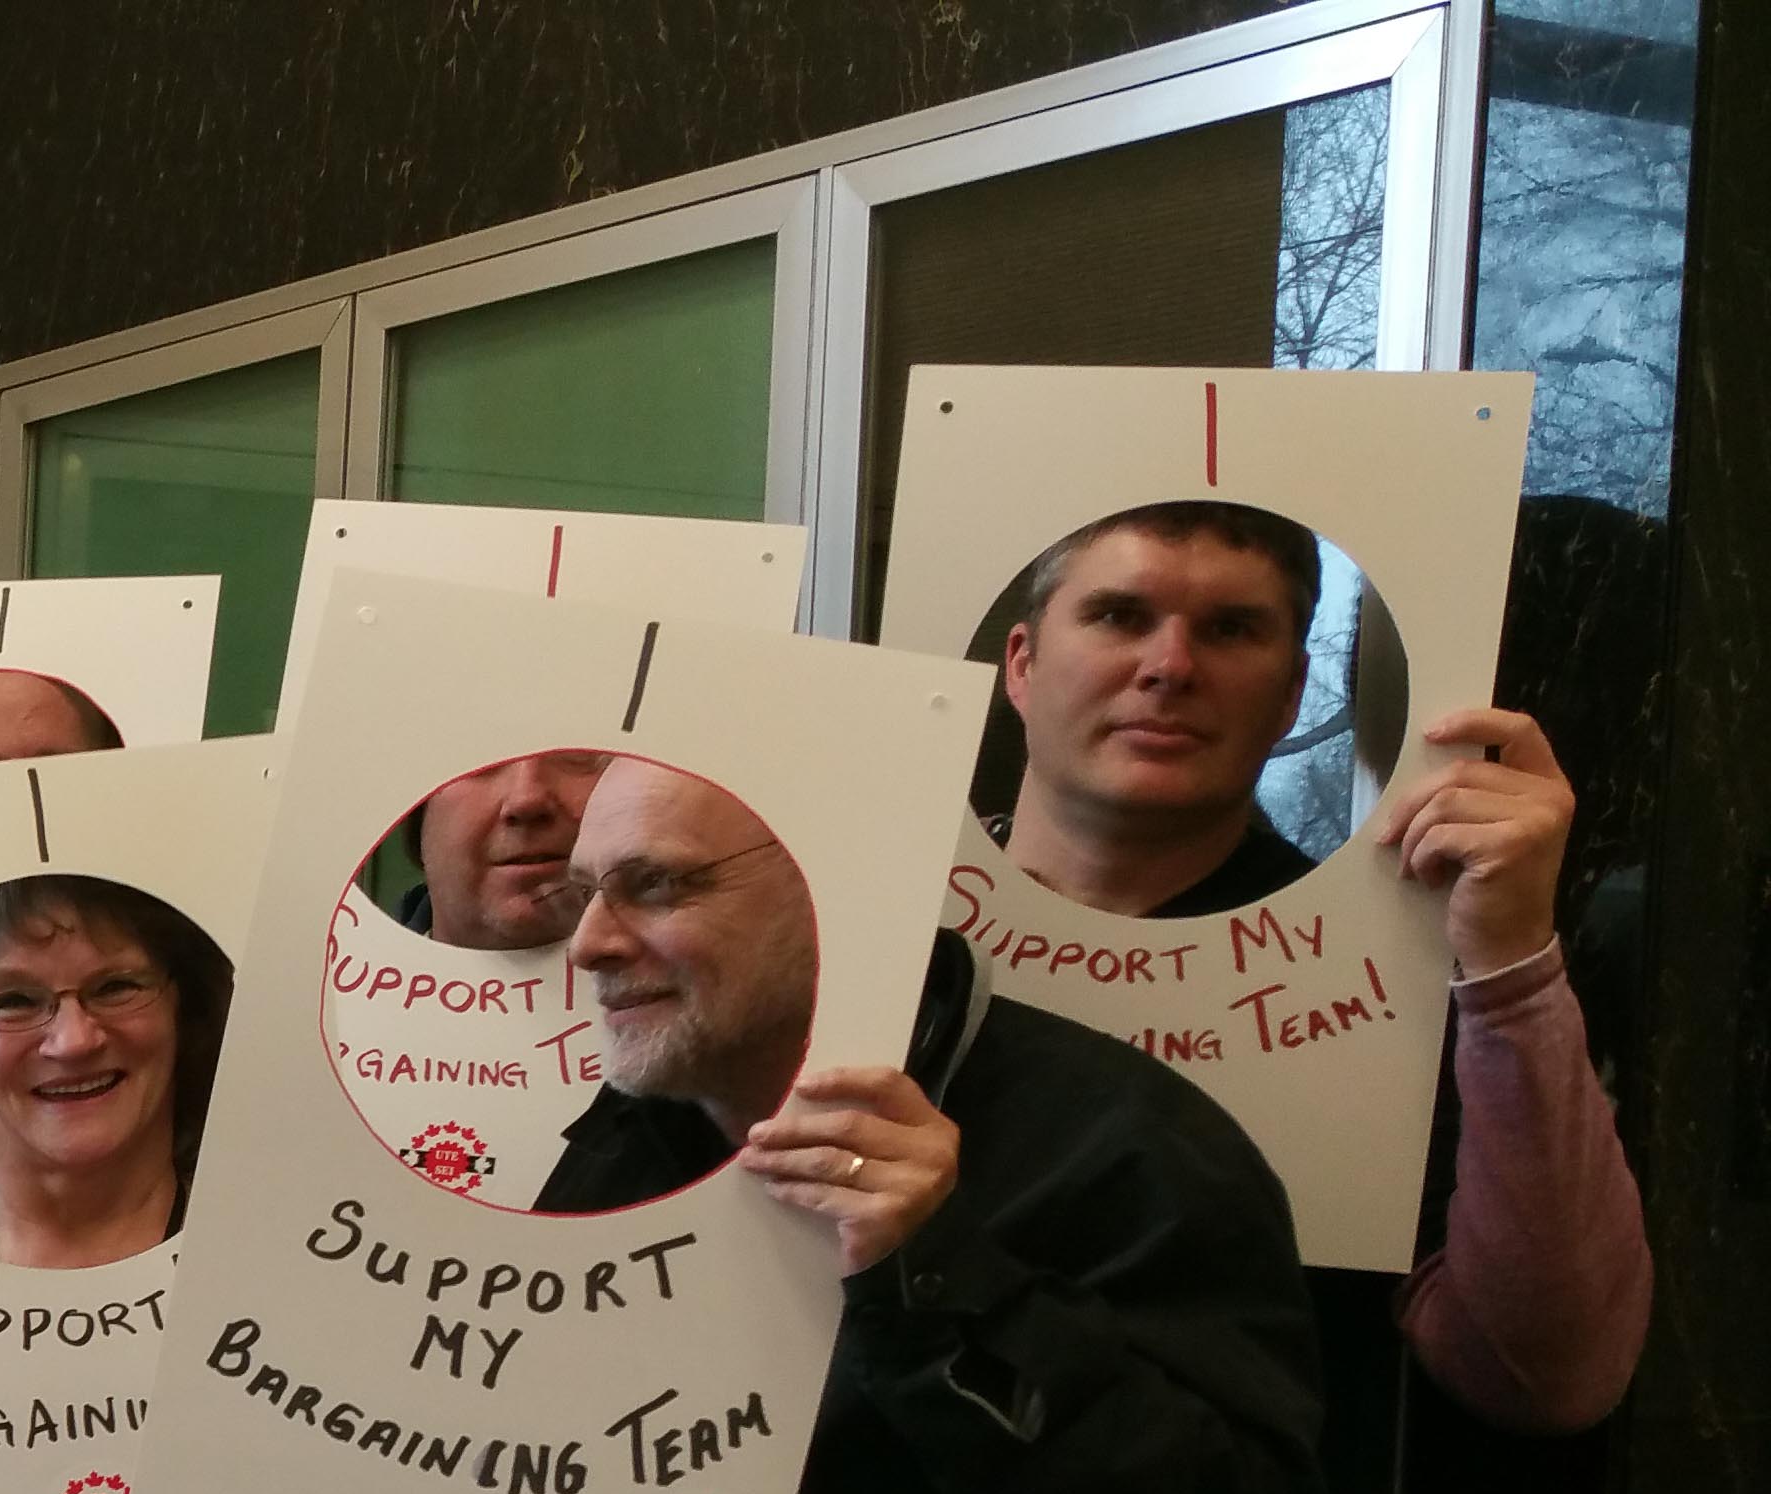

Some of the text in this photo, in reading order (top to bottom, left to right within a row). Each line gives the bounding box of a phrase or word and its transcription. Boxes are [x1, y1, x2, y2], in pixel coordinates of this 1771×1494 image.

[1228, 956, 1396, 1053] TEAM!
[434, 1150, 459, 1162] UTE
[434, 1165, 455, 1176] SEI
[306, 1199, 697, 1314] SUPPORT
[409, 1314, 523, 1389] MY
[604, 1388, 774, 1487] TEAM
